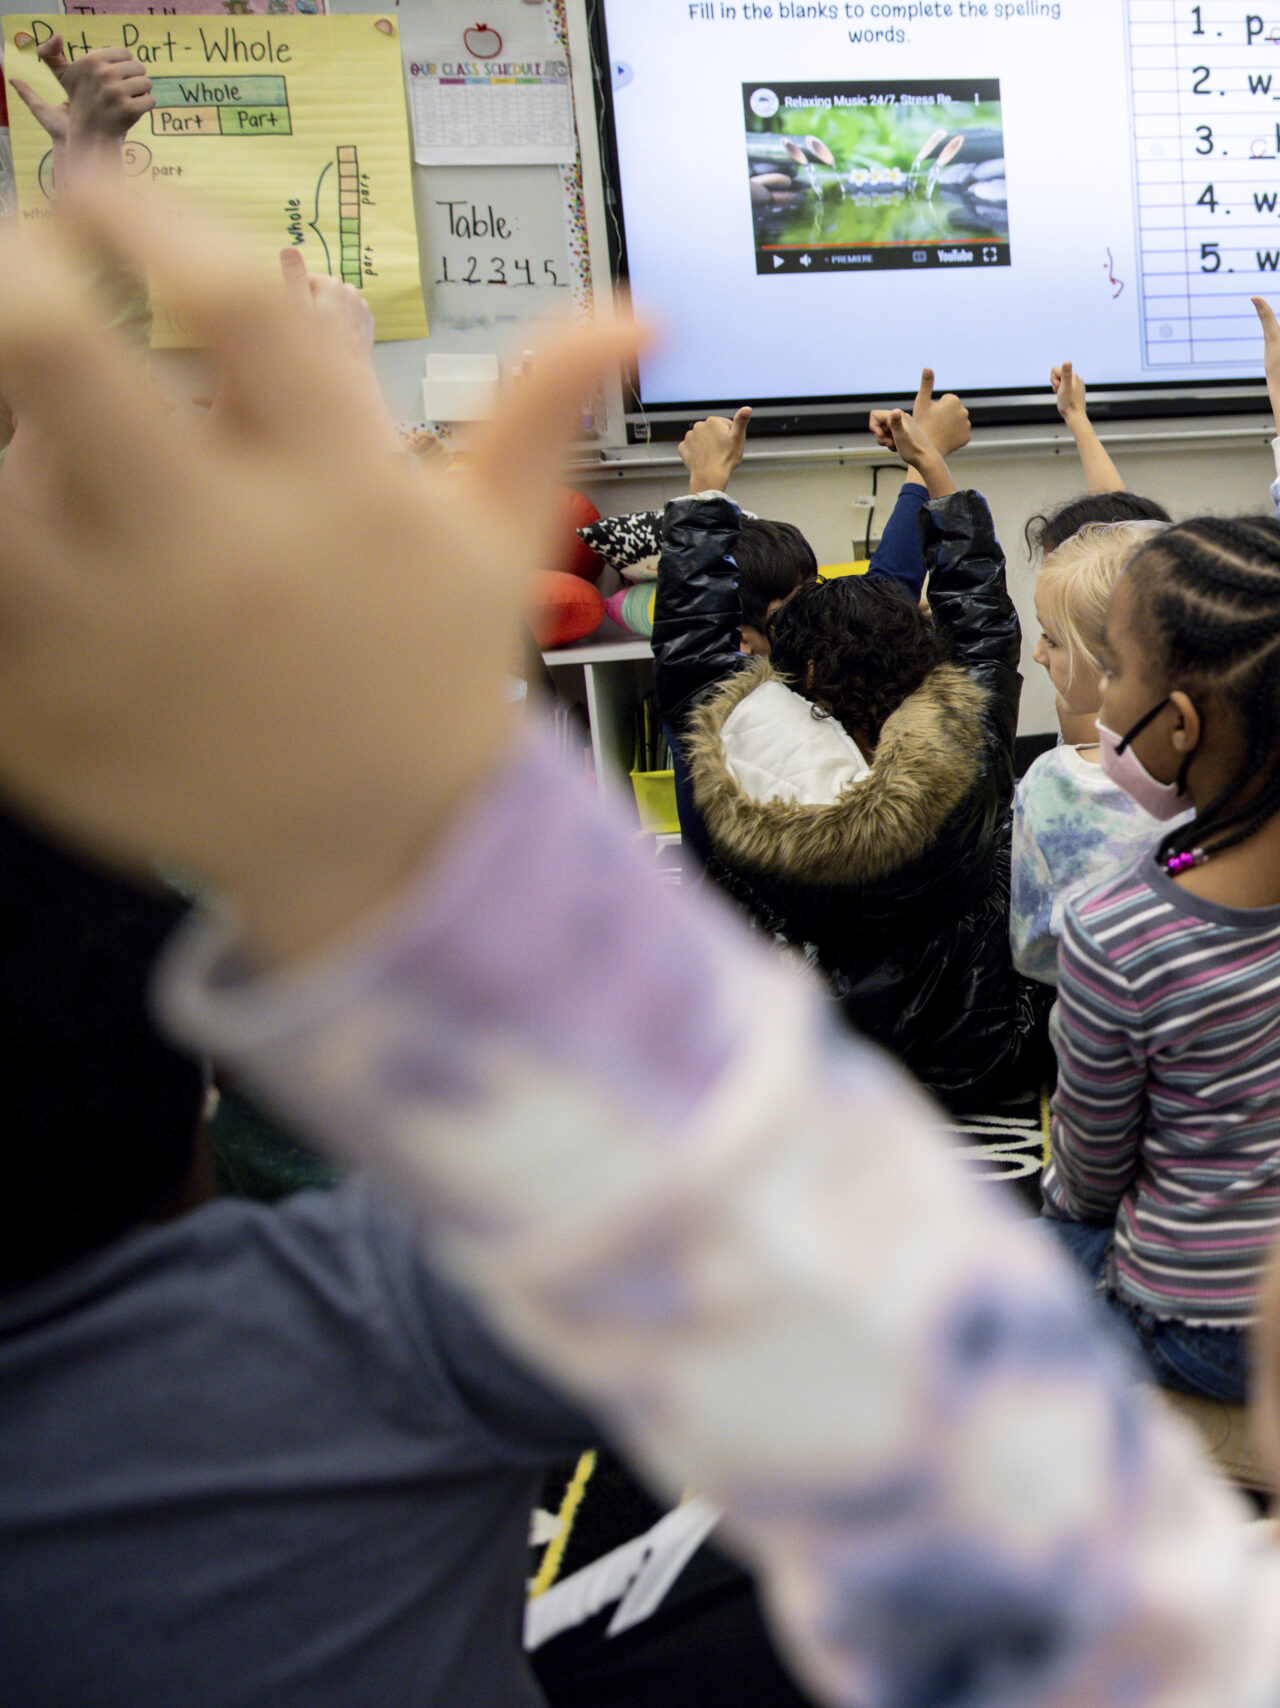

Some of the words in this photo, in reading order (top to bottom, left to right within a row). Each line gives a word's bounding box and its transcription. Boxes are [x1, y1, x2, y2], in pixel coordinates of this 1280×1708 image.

[688, 1, 715, 20] Fill
[721, 3, 737, 20] in
[743, 0, 773, 19] the
[779, 0, 839, 19] blanks
[844, 1, 865, 18] to
[870, 0, 953, 21] complete
[959, 0, 989, 18] the
[994, 0, 1062, 19] spelling
[122, 24, 178, 63] Part
[199, 27, 292, 63] Whole
[848, 26, 911, 44] words.
[410, 62, 438, 76] OUR
[442, 62, 480, 76] CLASS
[484, 61, 543, 76] SCHEDULE
[179, 83, 242, 103] Whole
[785, 95, 832, 110] Relaxing
[834, 94, 868, 108] Music
[900, 93, 935, 106] Stress
[161, 112, 203, 132] Part
[237, 110, 279, 129] Part
[125, 149, 136, 164] 5
[152, 165, 184, 182] part
[361, 173, 376, 205] part
[284, 199, 305, 246] whole
[364, 246, 379, 276] part
[937, 249, 974, 263] YouTube
[489, 256, 507, 284] 3
[515, 258, 535, 285] 4
